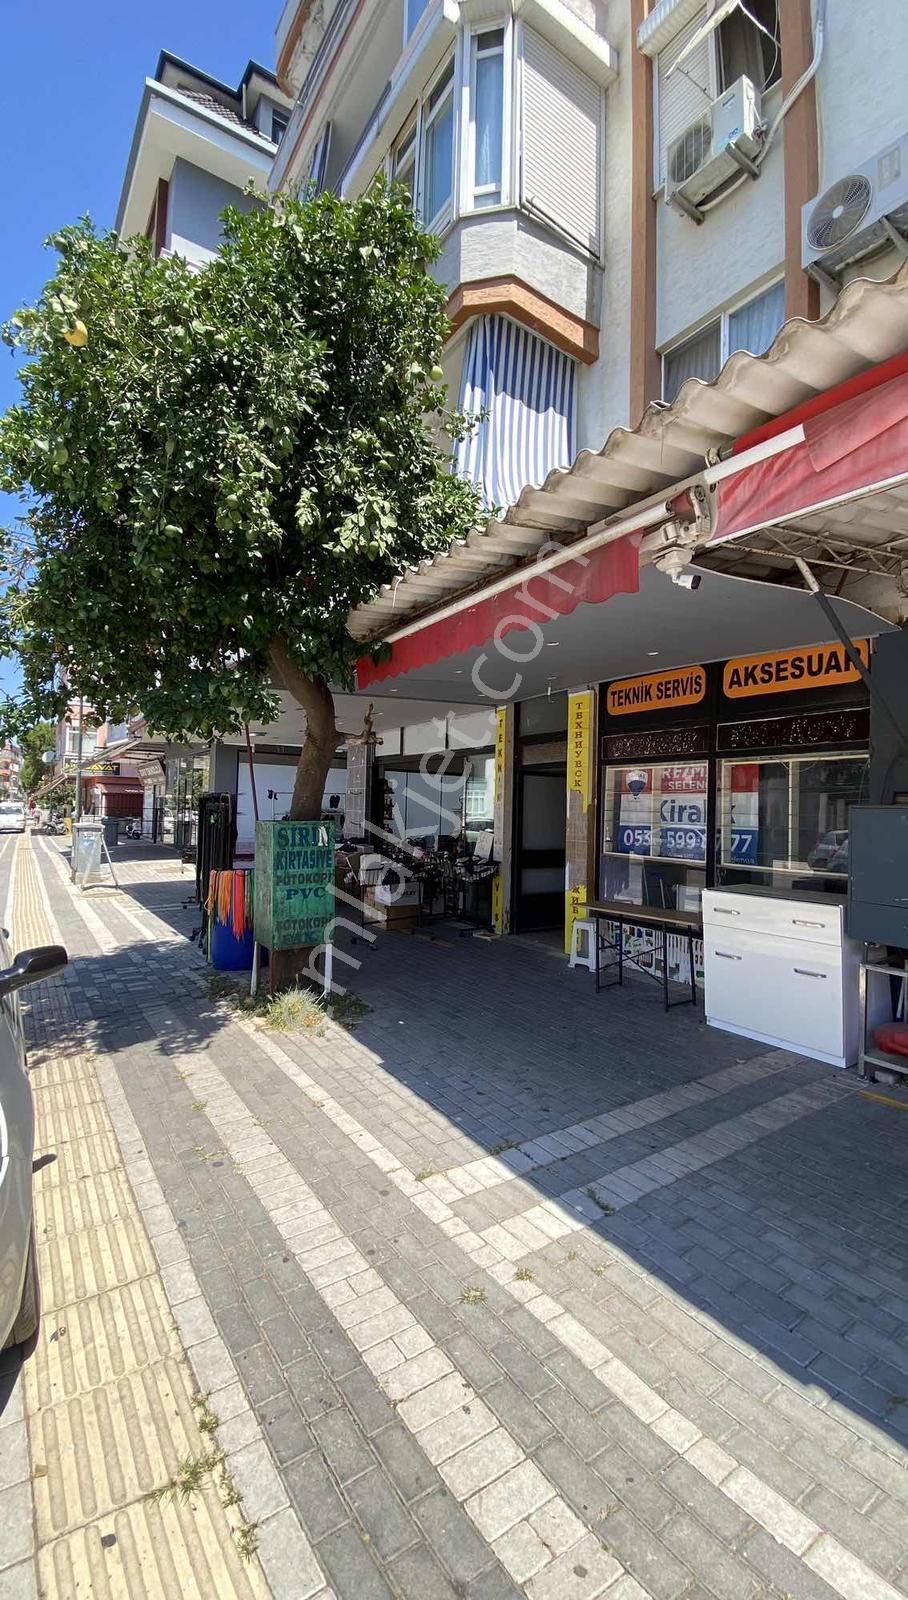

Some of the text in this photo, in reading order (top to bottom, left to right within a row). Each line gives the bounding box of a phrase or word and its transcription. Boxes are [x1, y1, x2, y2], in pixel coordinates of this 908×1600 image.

[728, 651, 862, 689] AKSESUAR
[610, 671, 703, 708] TEKNİK SERVİS
[285, 885, 326, 901] PVC
